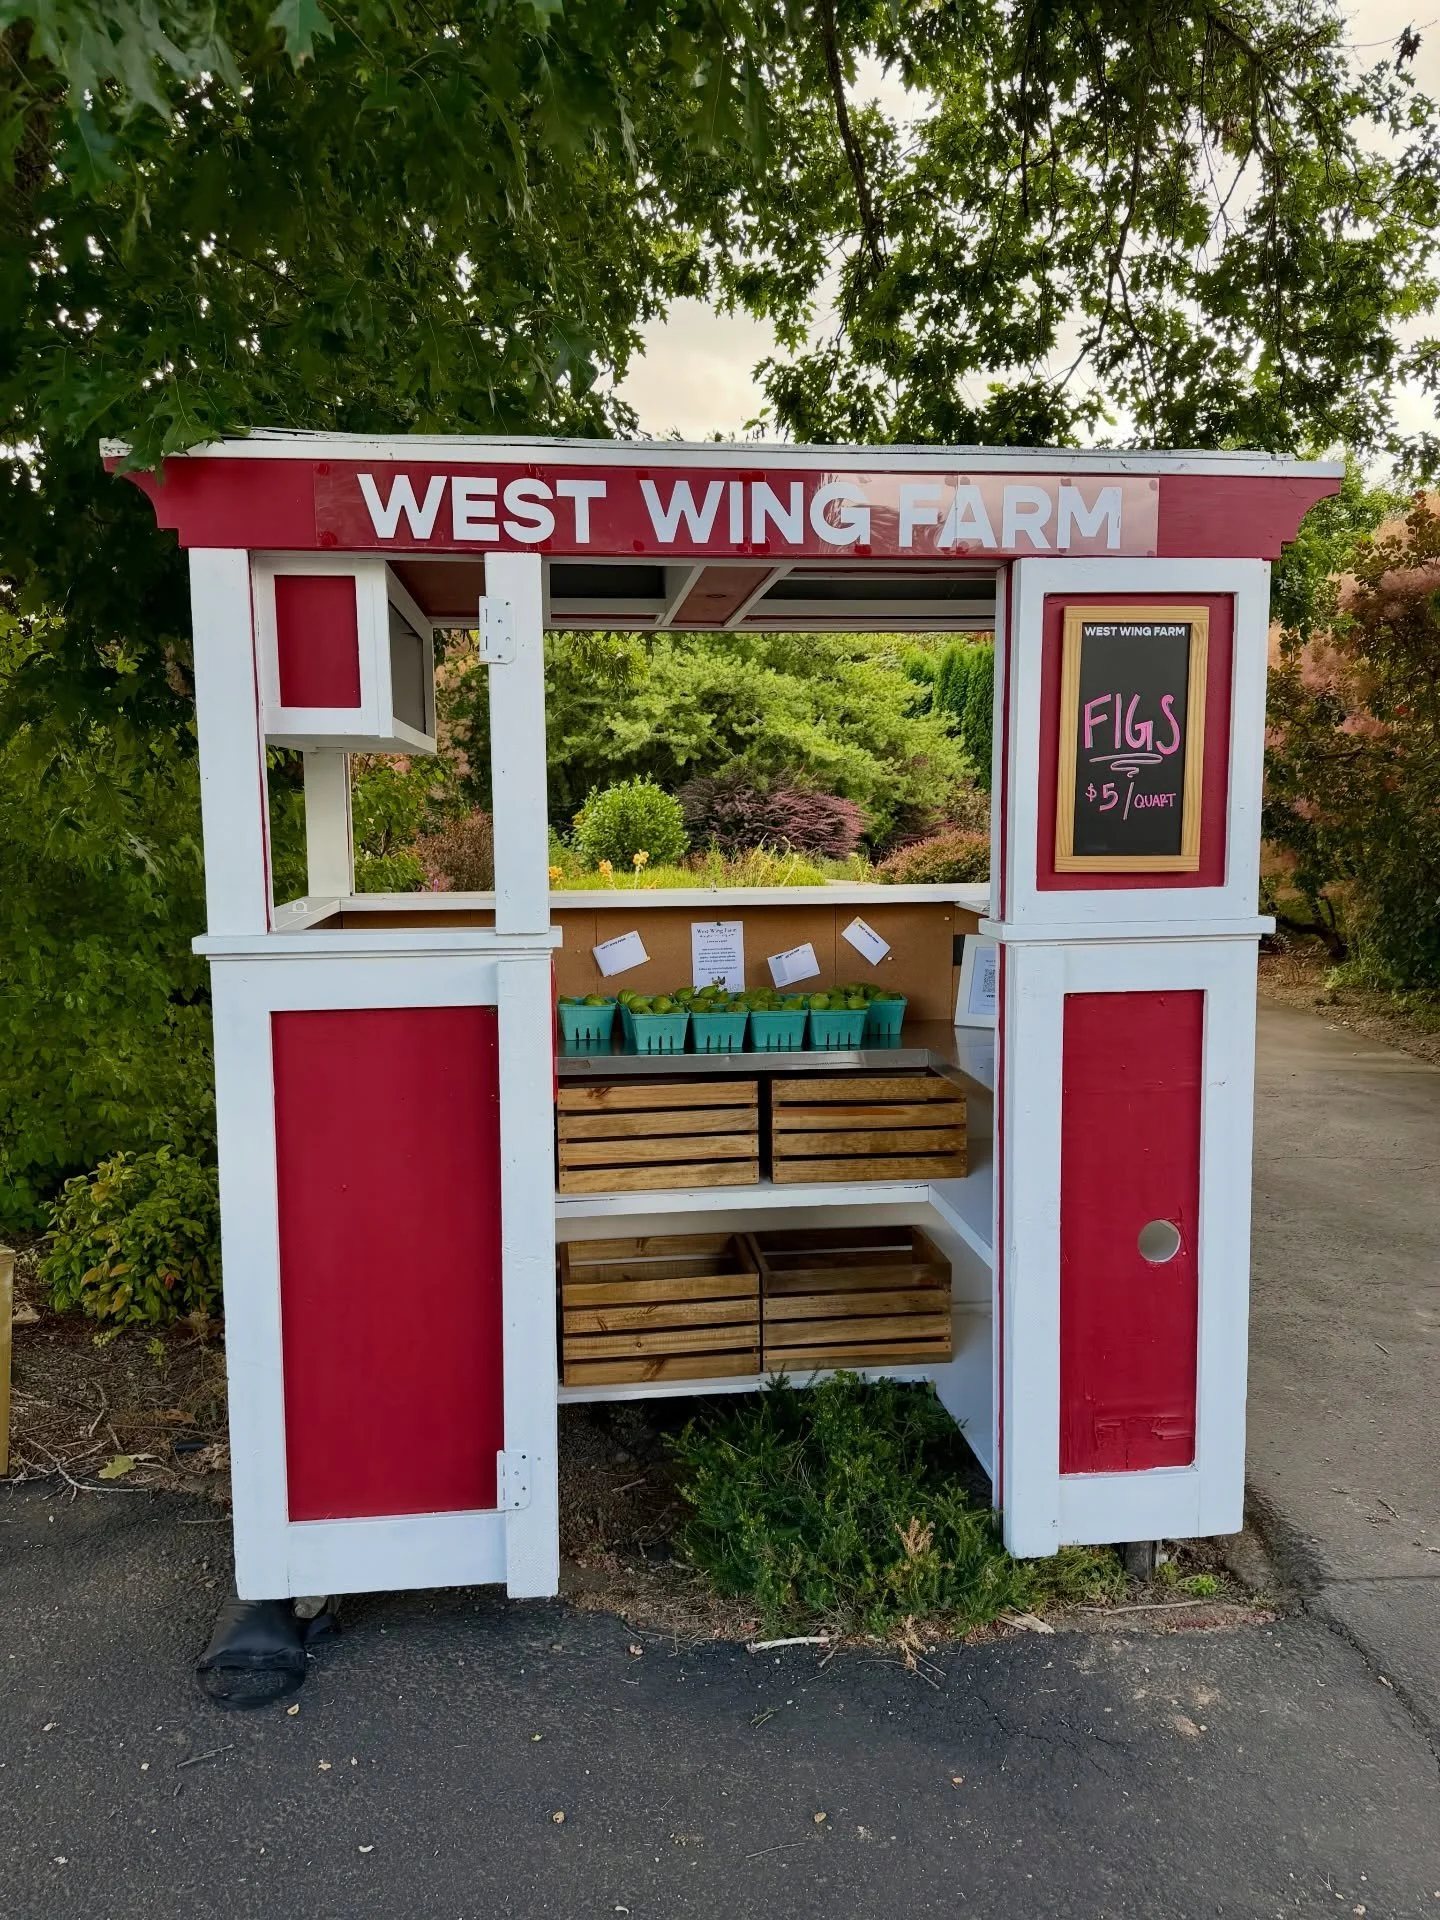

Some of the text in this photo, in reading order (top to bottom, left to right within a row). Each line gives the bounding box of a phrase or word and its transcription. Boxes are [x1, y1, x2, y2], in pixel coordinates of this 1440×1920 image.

[357, 473, 1123, 551] WEST WING FARM
[1084, 626, 1185, 636] WEST WING FARM
[1084, 693, 1181, 755] FIGS
